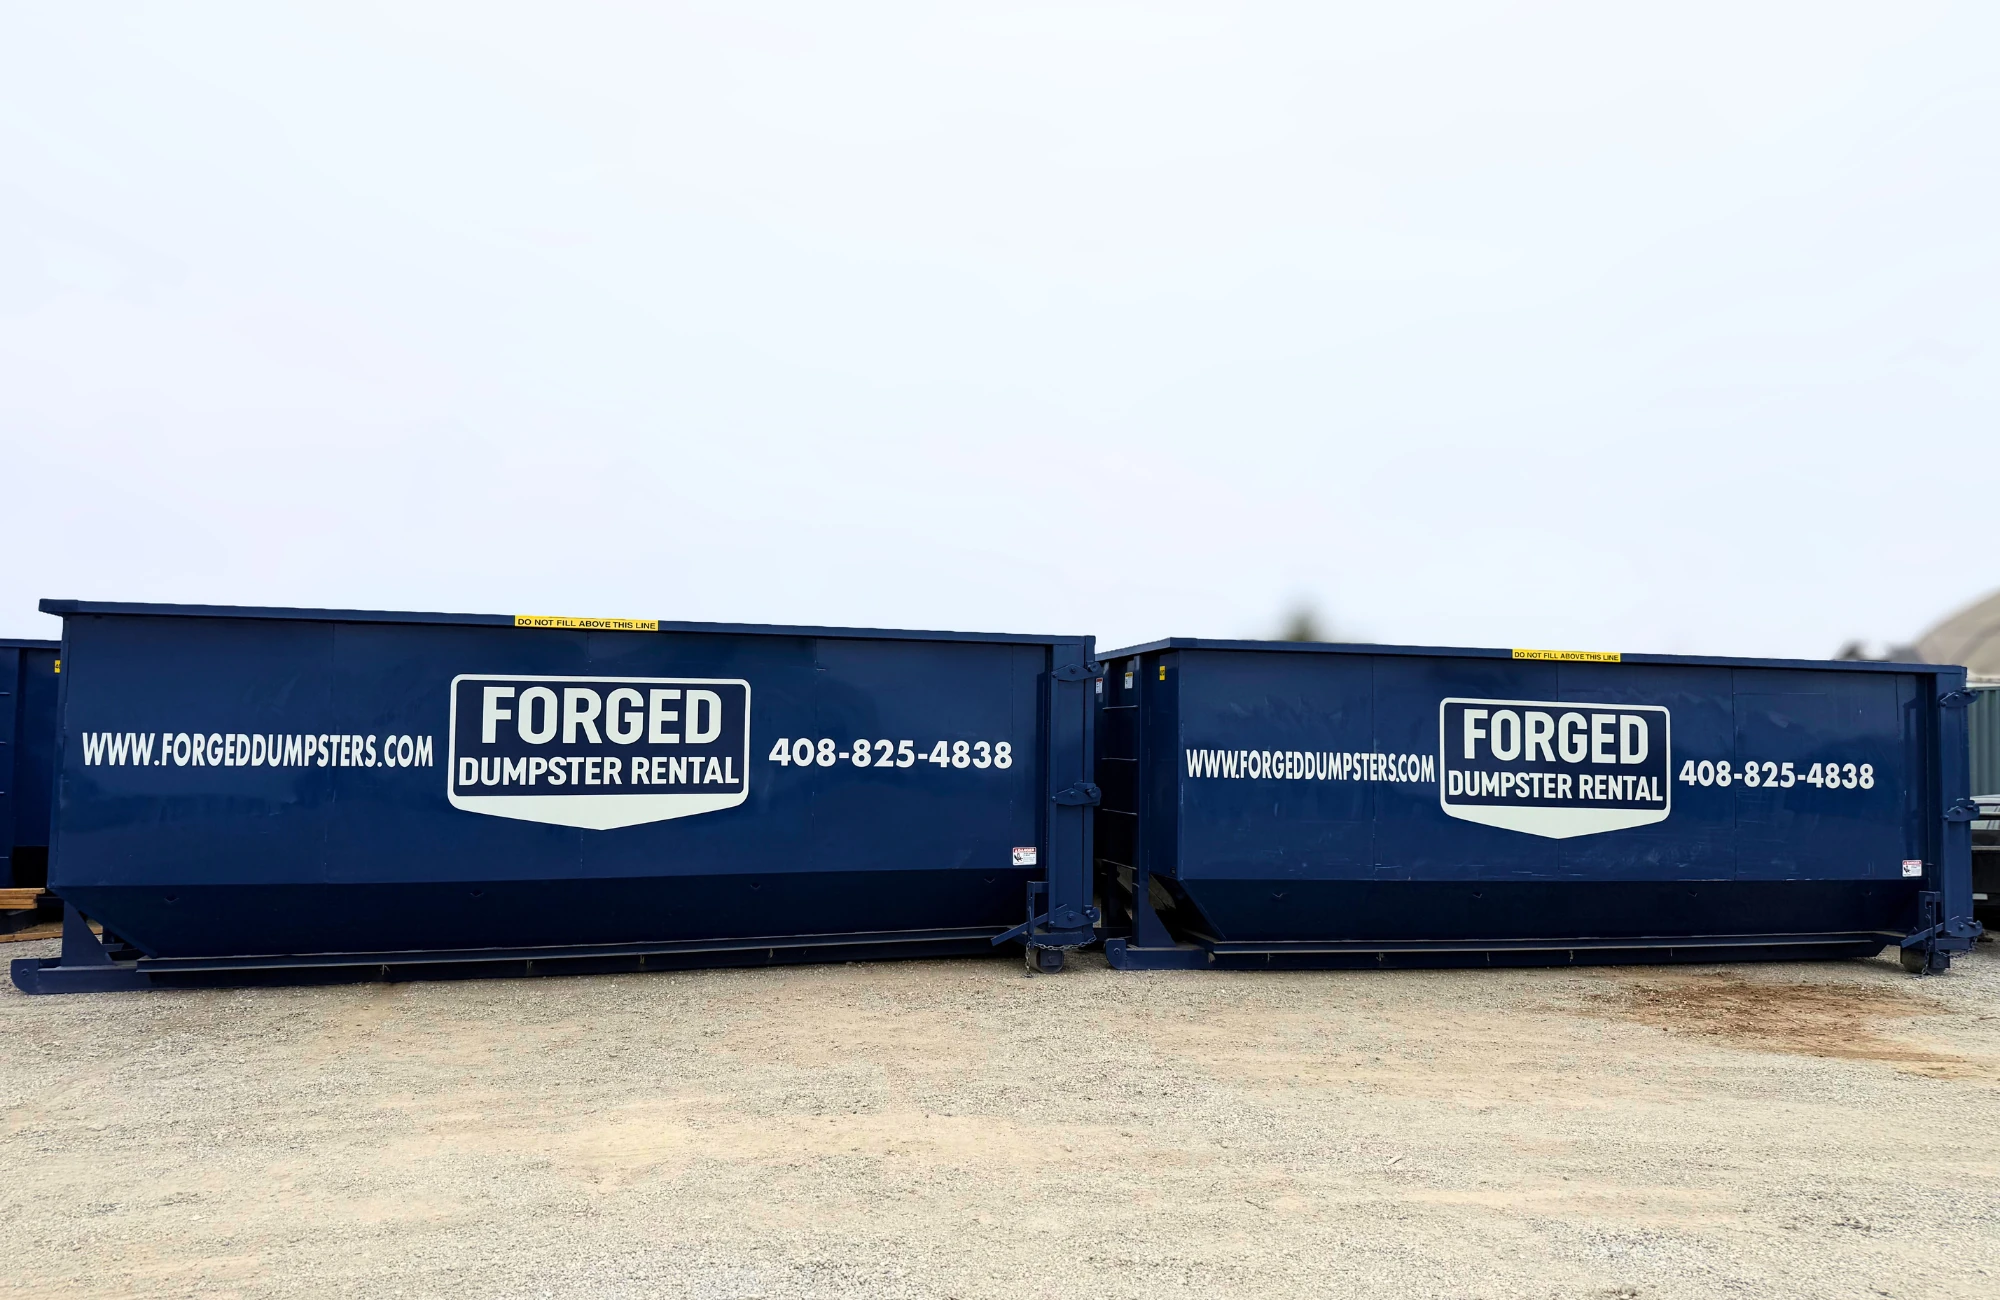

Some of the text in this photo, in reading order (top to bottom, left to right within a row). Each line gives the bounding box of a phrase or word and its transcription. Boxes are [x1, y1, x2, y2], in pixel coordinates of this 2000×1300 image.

[517, 618, 532, 626] DO
[578, 620, 611, 628] ABOVE
[612, 621, 633, 629] THIS
[635, 622, 656, 630] LINE
[1585, 653, 1602, 661] THIS
[482, 686, 722, 745] FORGED
[82, 732, 434, 768] WWW.FORGEDDUMPSTERS.COM
[1463, 708, 1649, 765] FORGED
[768, 737, 1013, 769] 408-825-4838
[1186, 748, 1436, 783] WWW.FORGEDDUMPSTERS.COM
[458, 756, 740, 786] DUMPSTER RENTAL
[1448, 769, 1664, 802] DUMPSTER RENTAL
[1678, 759, 1875, 790] 408-825-4838
